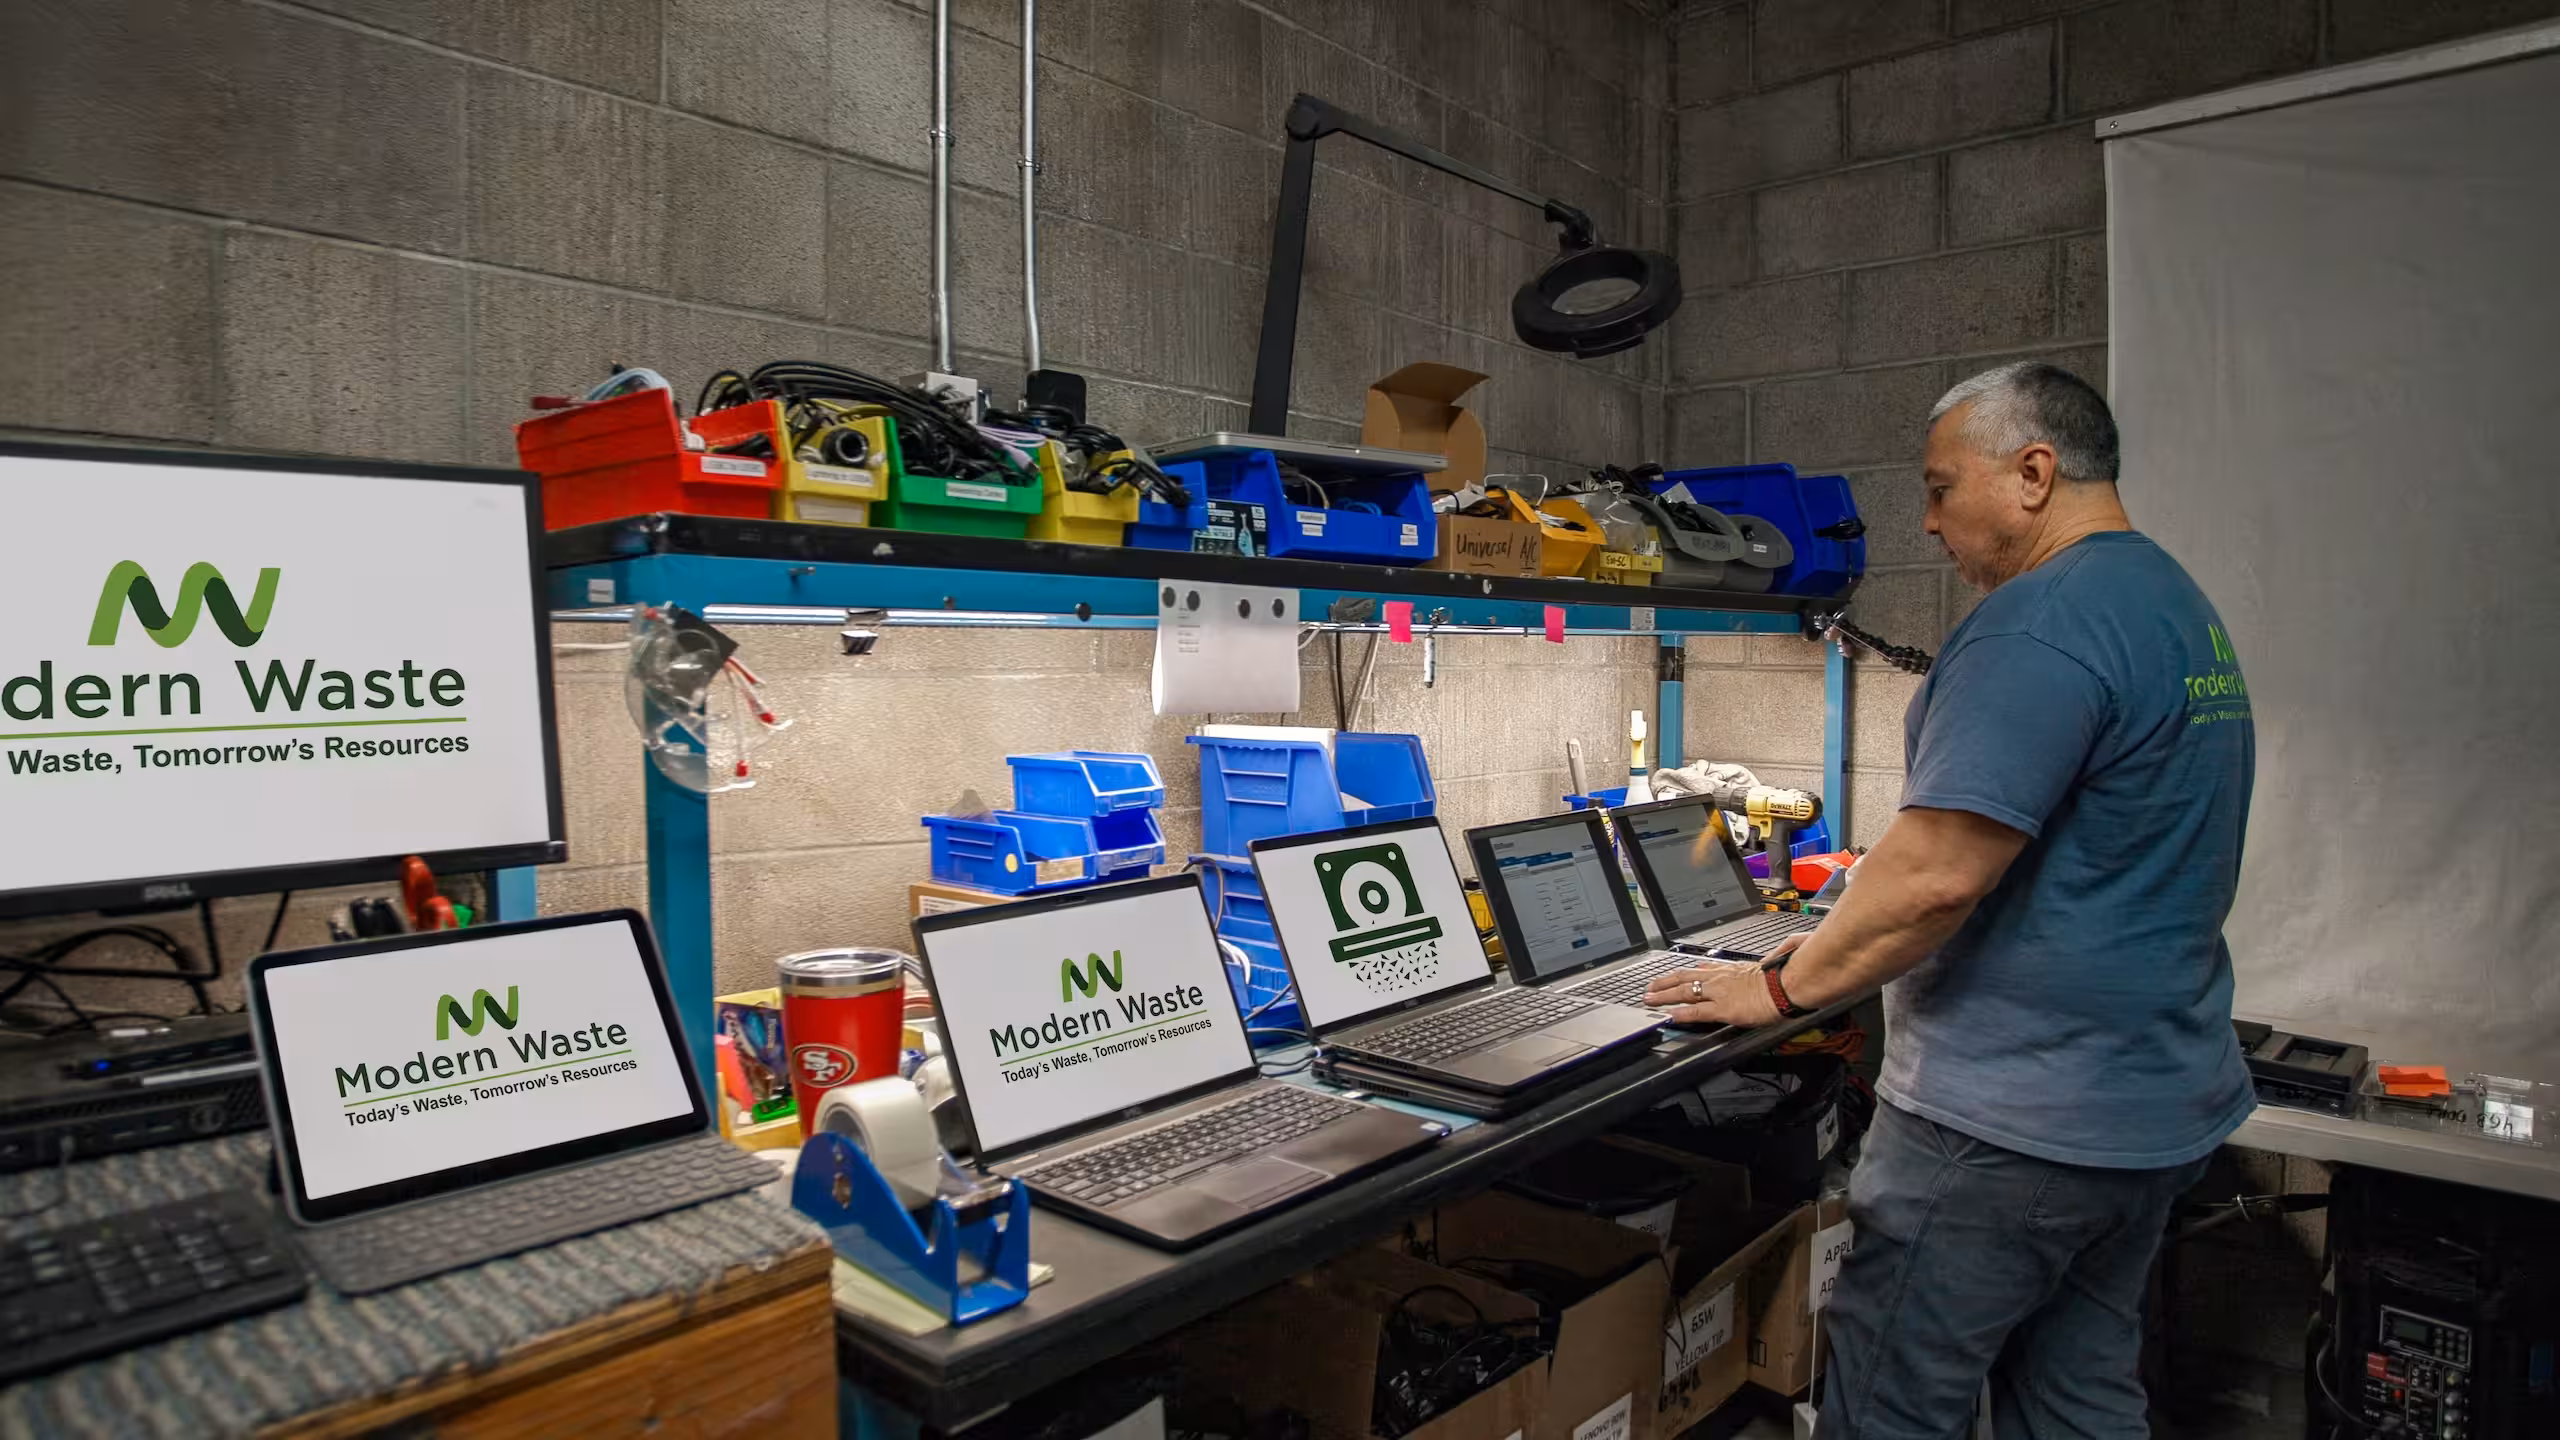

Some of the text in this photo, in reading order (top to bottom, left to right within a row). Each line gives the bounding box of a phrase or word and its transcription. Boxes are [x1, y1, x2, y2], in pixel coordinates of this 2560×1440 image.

[1456, 531, 1513, 558] Universal
[235, 659, 465, 712] Waste
[8, 737, 469, 775] Waste, Tomorrow's Resources
[990, 985, 1203, 1057] Modern Waste
[335, 1022, 628, 1098] Modern Waste
[1002, 1018, 1212, 1084] Today's Waste, Tomorrow's Resources
[345, 1060, 638, 1127] Today's Waste, Tomorrow's Resources
[1824, 1238, 1852, 1265] APPL
[1691, 1303, 1716, 1334] 65W
[1674, 1329, 1725, 1372] YELLOW TIP
